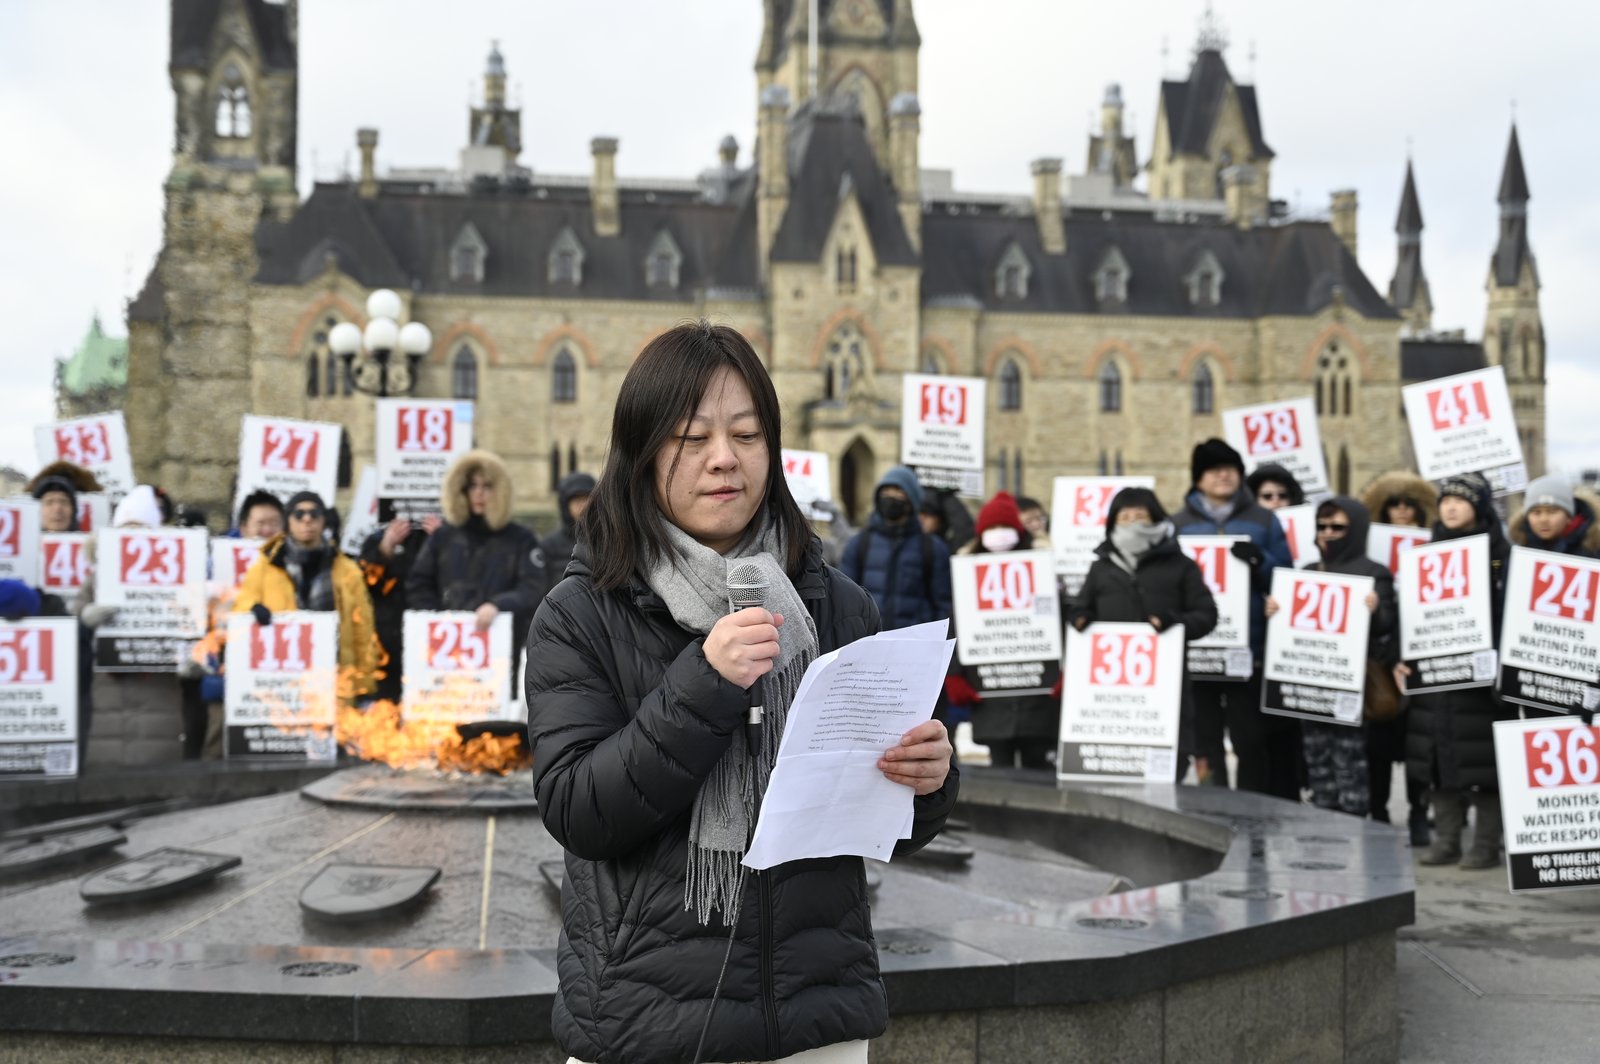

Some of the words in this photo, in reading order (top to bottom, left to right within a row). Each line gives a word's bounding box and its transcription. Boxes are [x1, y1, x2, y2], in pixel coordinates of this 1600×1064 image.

[924, 385, 964, 424] 19
[1435, 383, 1486, 429] 41
[402, 409, 447, 452] 18
[1248, 410, 1296, 455] 28
[60, 423, 108, 465] 33
[265, 427, 317, 471] 27
[126, 536, 179, 586] 23
[982, 561, 1034, 609] 40
[1422, 548, 1467, 603] 34
[1534, 562, 1591, 620] 24
[1294, 582, 1345, 633] 20
[1424, 606, 1465, 619] MONTHS
[1457, 619, 1476, 630] FOR
[1532, 622, 1585, 640] MONTHS
[257, 623, 305, 672] 11
[432, 621, 487, 669] 25
[1293, 637, 1338, 650] MONTHS
[1430, 633, 1483, 648] RESPONSE
[1519, 634, 1569, 654] WAITING
[1573, 642, 1598, 658] FOR
[1094, 633, 1153, 686] 36
[1328, 656, 1349, 667] FOR
[1298, 667, 1354, 682] RESPONSE
[1517, 668, 1534, 684] NO
[1520, 683, 1537, 699] NO
[32, 706, 58, 718] FOR
[1135, 709, 1161, 721] FOR
[1531, 726, 1599, 788] 36
[1537, 792, 1600, 809] MONTHS
[1522, 811, 1585, 827] WAITING
[1516, 830, 1548, 845] IRCC
[1532, 853, 1551, 870] NO
[1539, 868, 1559, 884] NO
